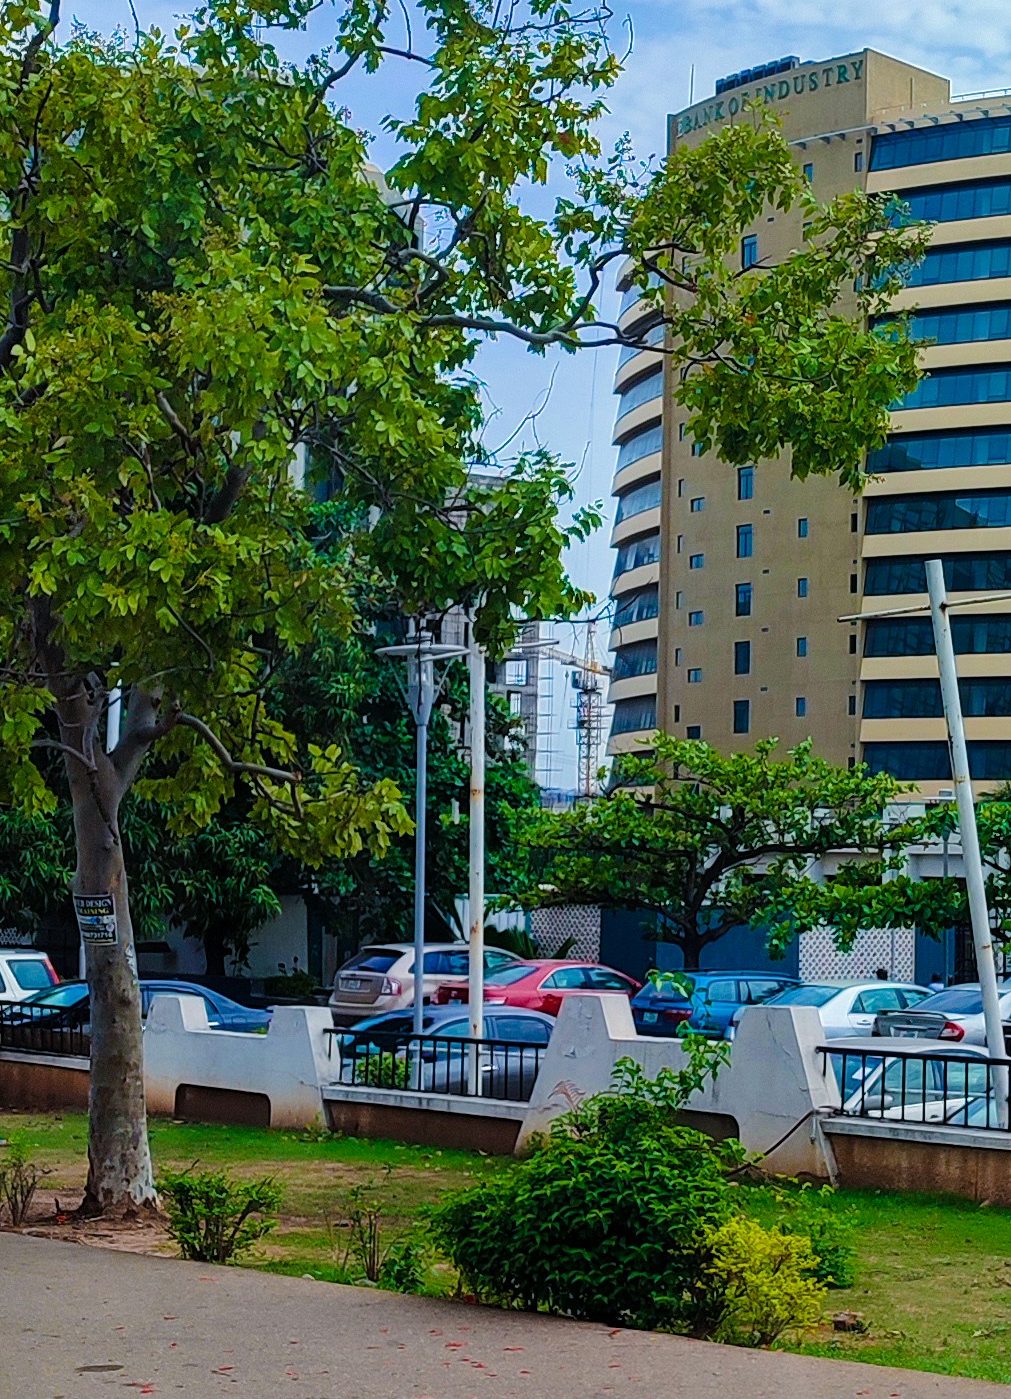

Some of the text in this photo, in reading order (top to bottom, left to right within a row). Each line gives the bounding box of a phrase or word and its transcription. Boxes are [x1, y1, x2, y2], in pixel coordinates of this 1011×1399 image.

[677, 100, 725, 138] BANK
[728, 91, 749, 116] OF
[86, 899, 112, 907] DESIGN
